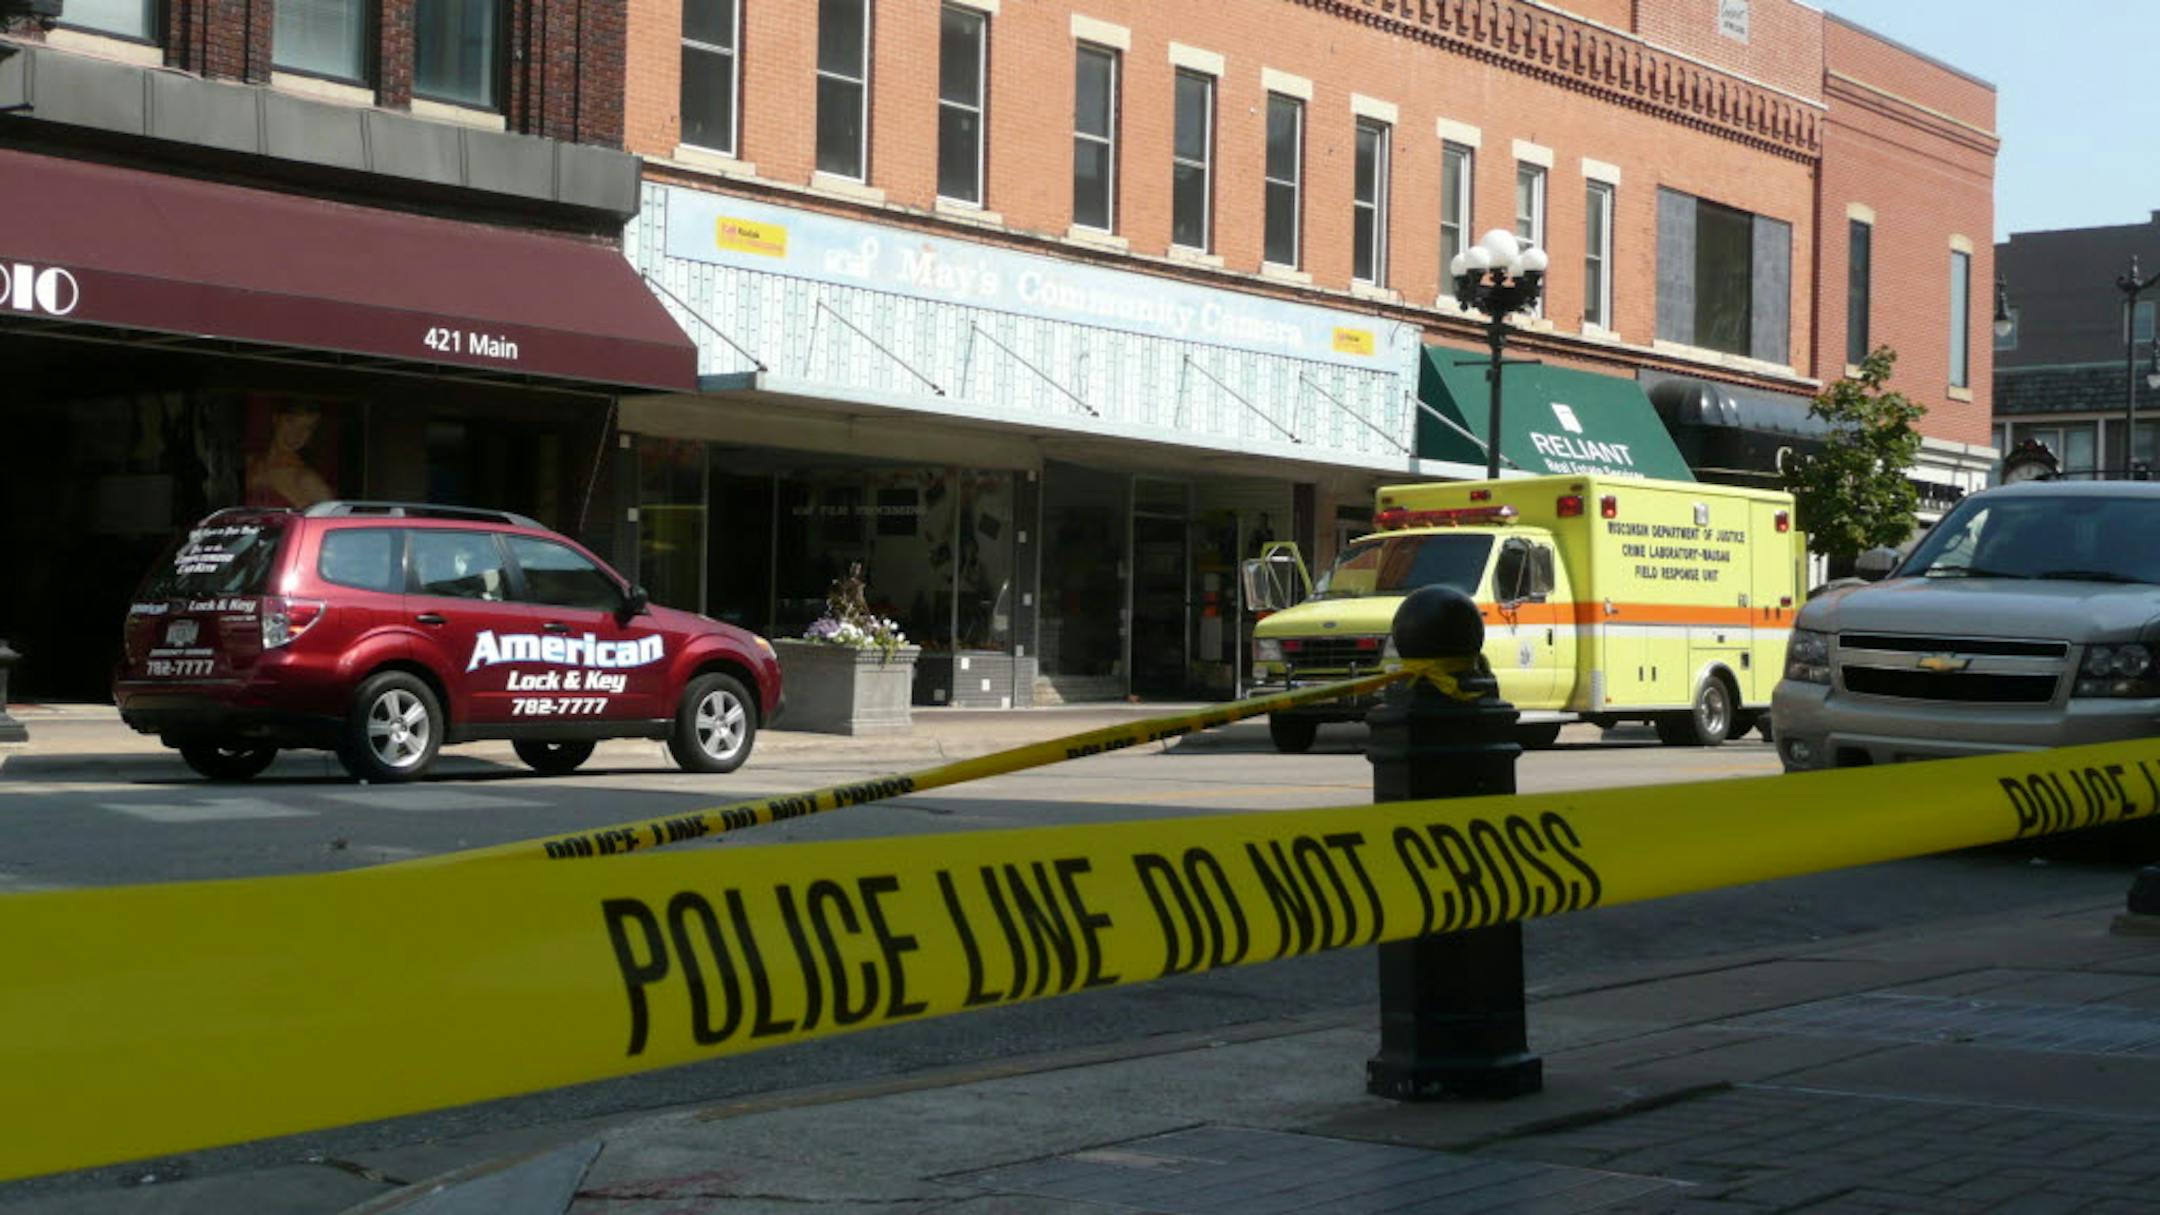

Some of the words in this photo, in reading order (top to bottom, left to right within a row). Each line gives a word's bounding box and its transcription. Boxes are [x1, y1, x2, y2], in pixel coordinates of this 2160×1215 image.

[0, 262, 79, 315] IO
[897, 247, 998, 296] May's
[1017, 271, 1194, 334] Community
[1201, 303, 1304, 349] Camera
[424, 327, 460, 352] 421
[469, 332, 518, 360] Main
[1529, 431, 1634, 467] RELIANT
[1607, 521, 1649, 537] WISCONSIN
[1651, 524, 1700, 540] DEPARTMENT
[1703, 528, 1713, 541] OF
[1716, 530, 1746, 544] JUSTICE
[1622, 543, 1646, 558] CRIME
[1635, 565, 1658, 579] FIELD
[1661, 566, 1699, 581] RESPONSE
[1702, 569, 1719, 582] UNIT
[146, 659, 215, 677] 782-7777
[465, 629, 666, 674] American
[506, 670, 561, 691] Lock
[562, 670, 582, 691] &
[584, 670, 628, 694] Key
[511, 697, 609, 716] 782-7777
[1997, 763, 2137, 837] POLICE
[601, 875, 929, 1057] POLICE
[935, 856, 1121, 1008] LINE
[1131, 845, 1251, 979] DO
[1244, 831, 1386, 961] NOT
[1391, 809, 1603, 939] CROSS
